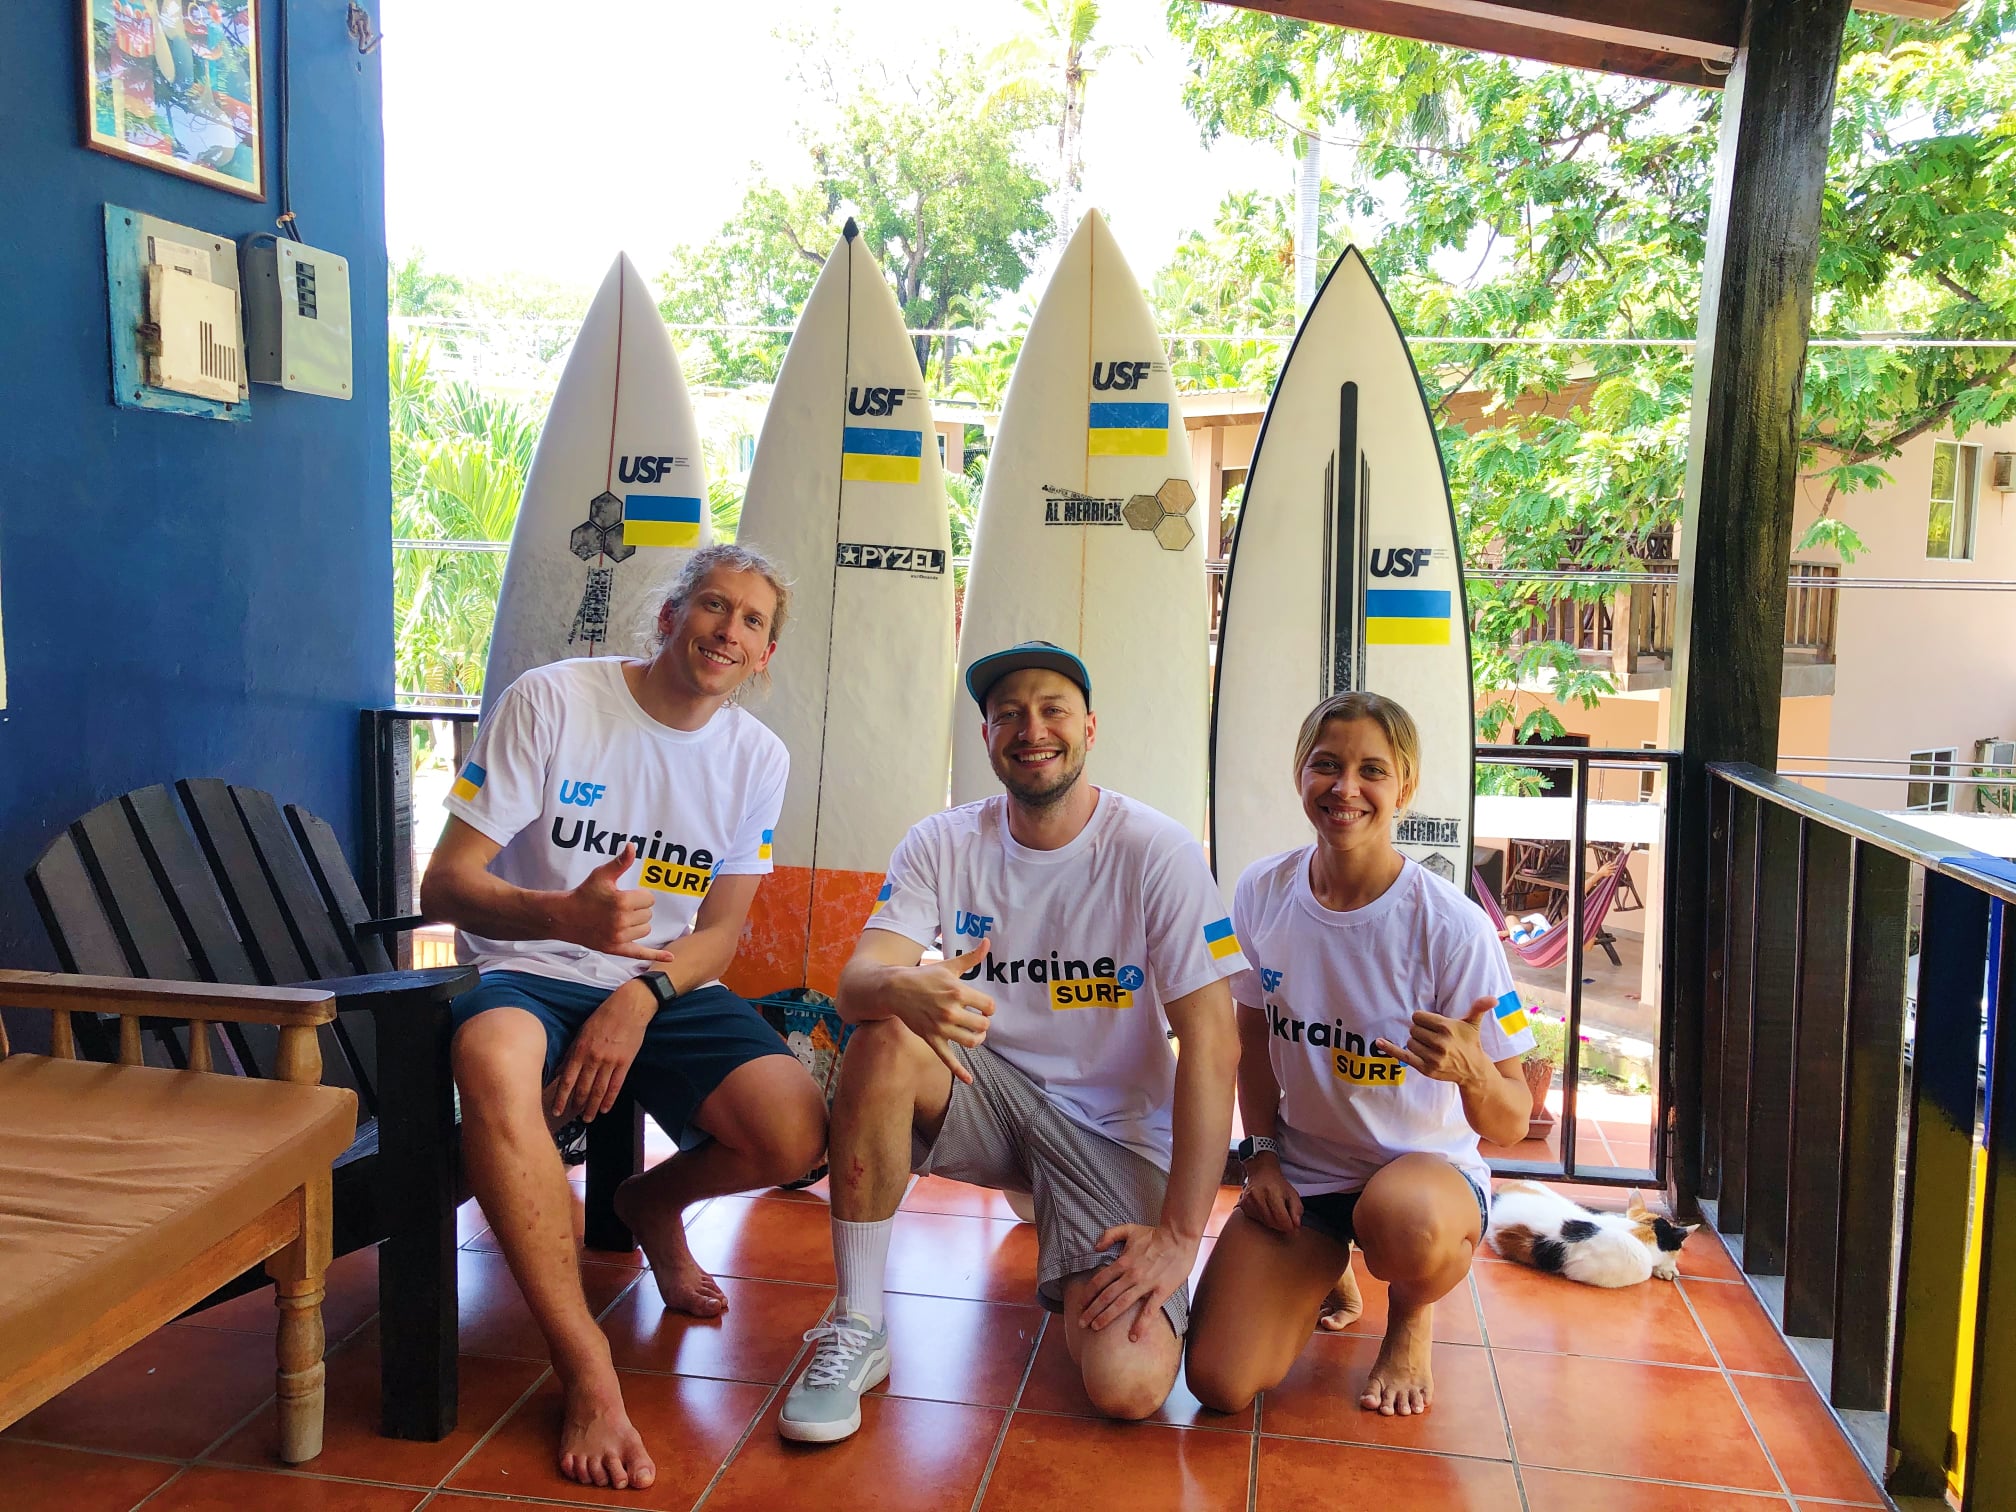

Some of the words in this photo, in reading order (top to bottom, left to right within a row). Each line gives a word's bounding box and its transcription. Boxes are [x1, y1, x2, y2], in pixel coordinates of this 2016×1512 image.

[1092, 361, 1151, 391] USF
[848, 386, 906, 416] USF
[618, 455, 674, 484] USF
[1045, 502, 1060, 522] AL
[1064, 502, 1122, 522] MERRICK
[860, 546, 941, 573] PYZEL
[1370, 547, 1432, 578] USF
[559, 779, 607, 807] USF
[551, 816, 714, 870] Ukraine
[1396, 819, 1459, 843] MERRICK
[955, 910, 994, 939] USF
[1056, 983, 1127, 1004] SURF
[1336, 1054, 1403, 1081] SURF
